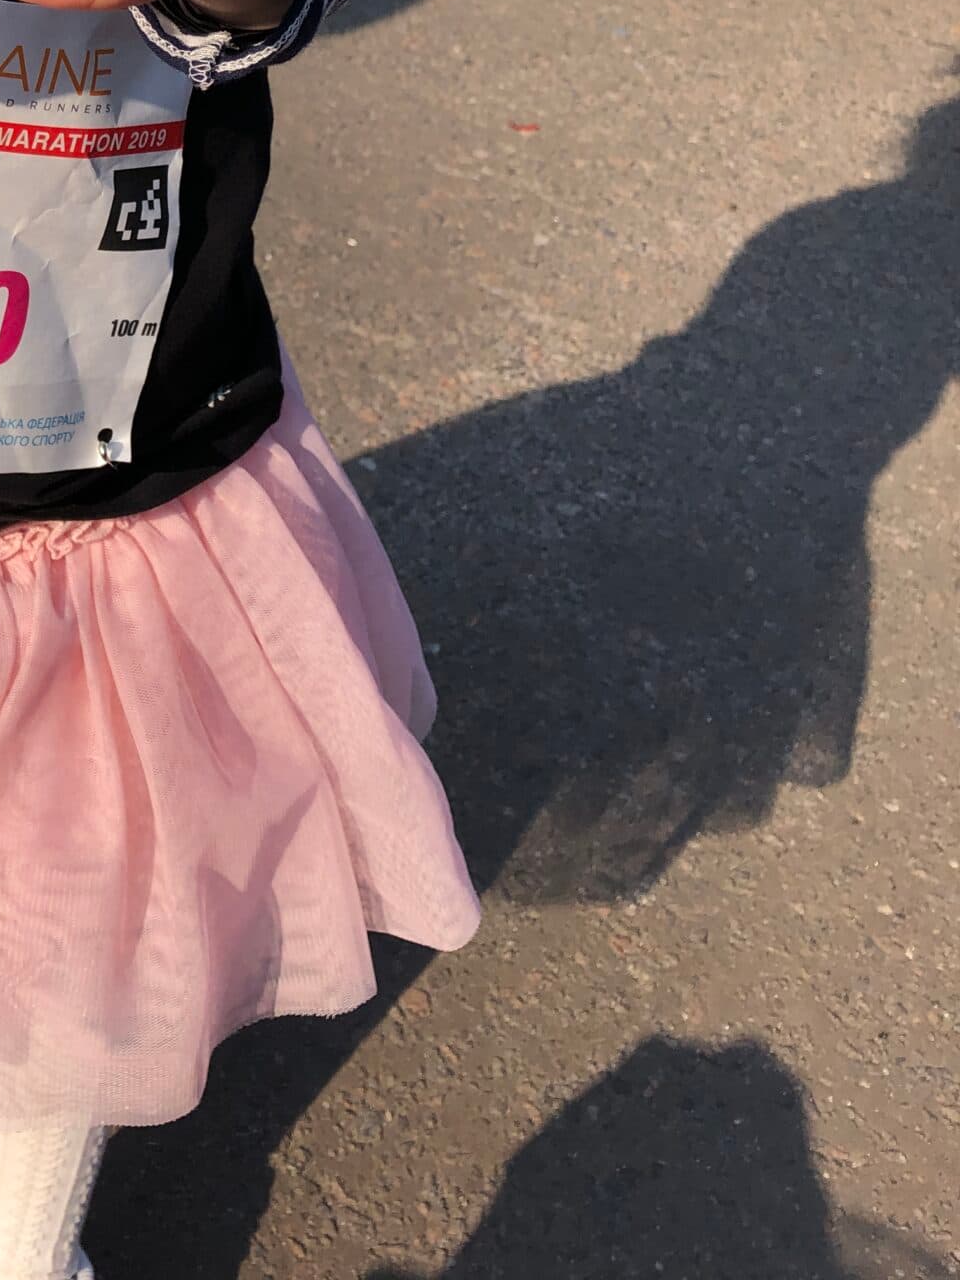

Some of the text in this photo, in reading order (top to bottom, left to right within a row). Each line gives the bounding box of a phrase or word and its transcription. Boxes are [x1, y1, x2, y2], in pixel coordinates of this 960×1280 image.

[29, 100, 113, 115] RUNNERS
[127, 128, 168, 149] 2019
[110, 320, 158, 337] 100 m
[26, 410, 86, 430] ФЕДЕРАЦІЯ
[30, 430, 77, 447] СПОРТУ
